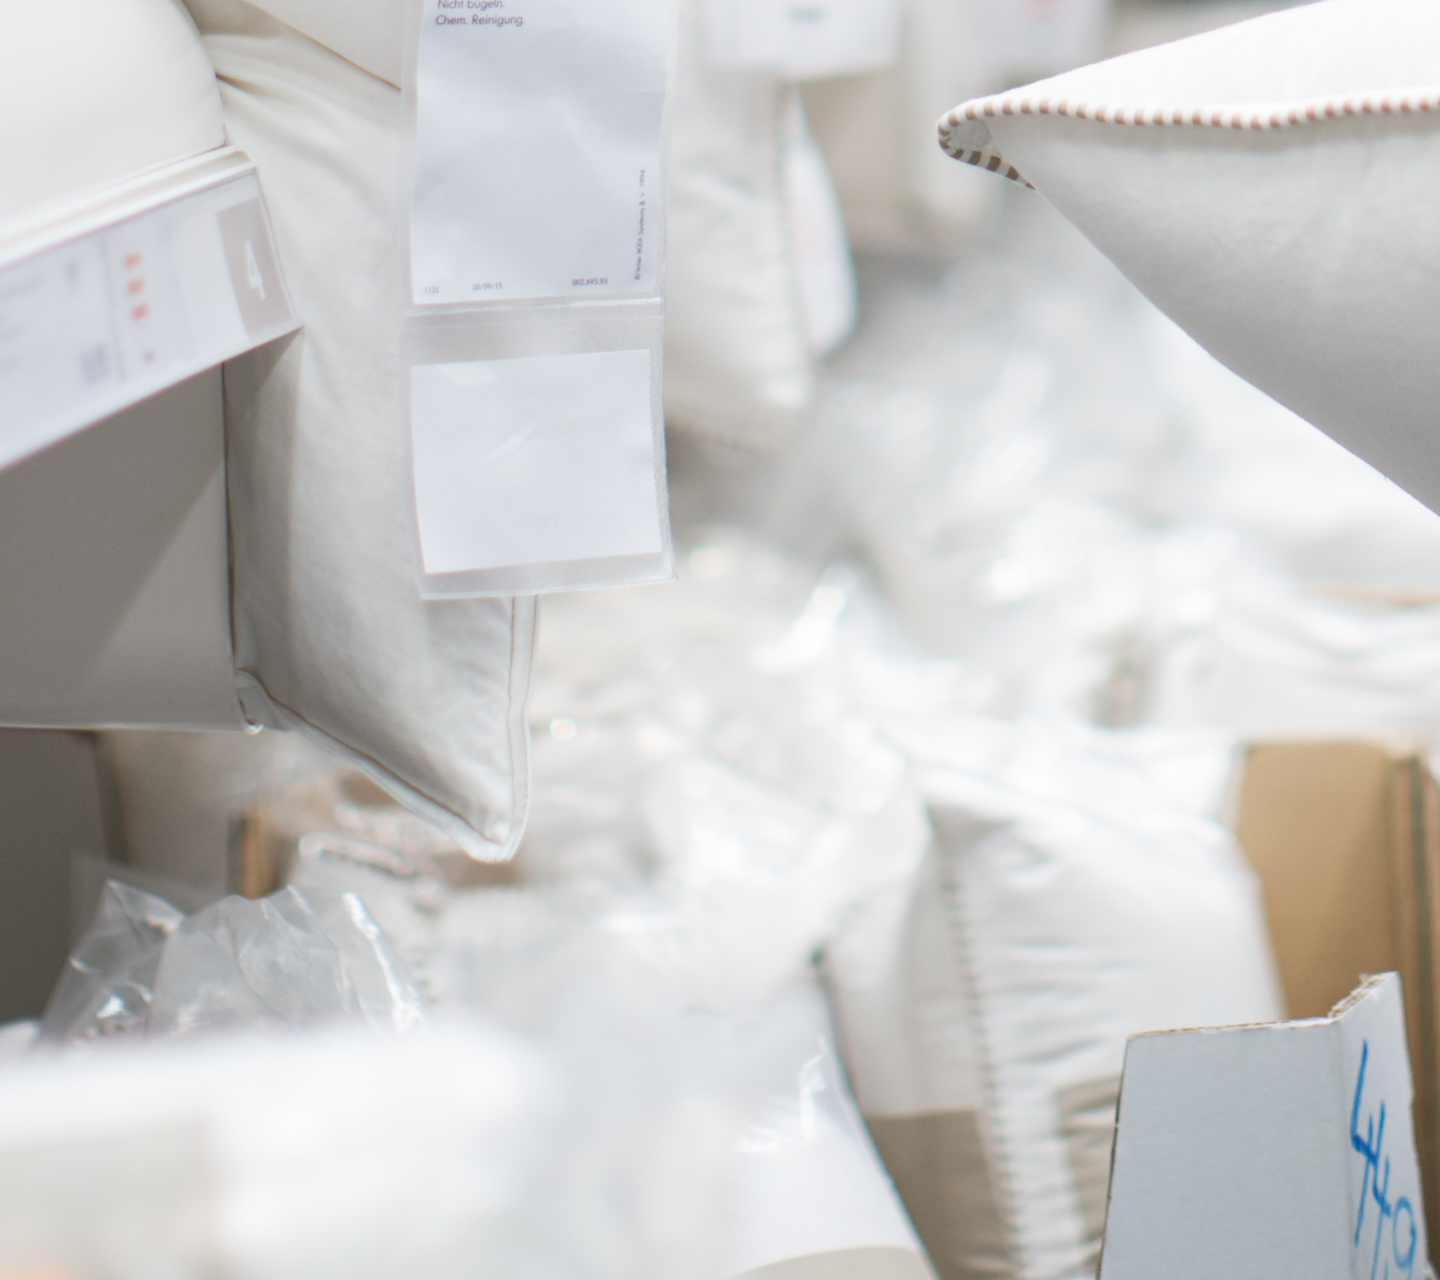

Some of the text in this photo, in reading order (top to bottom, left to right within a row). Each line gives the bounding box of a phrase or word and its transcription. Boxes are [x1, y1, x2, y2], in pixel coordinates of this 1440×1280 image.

[437, 0, 504, 10] Nicht bügeln.
[436, 15, 525, 27] Chem. Reinigung.
[246, 240, 266, 300] 4
